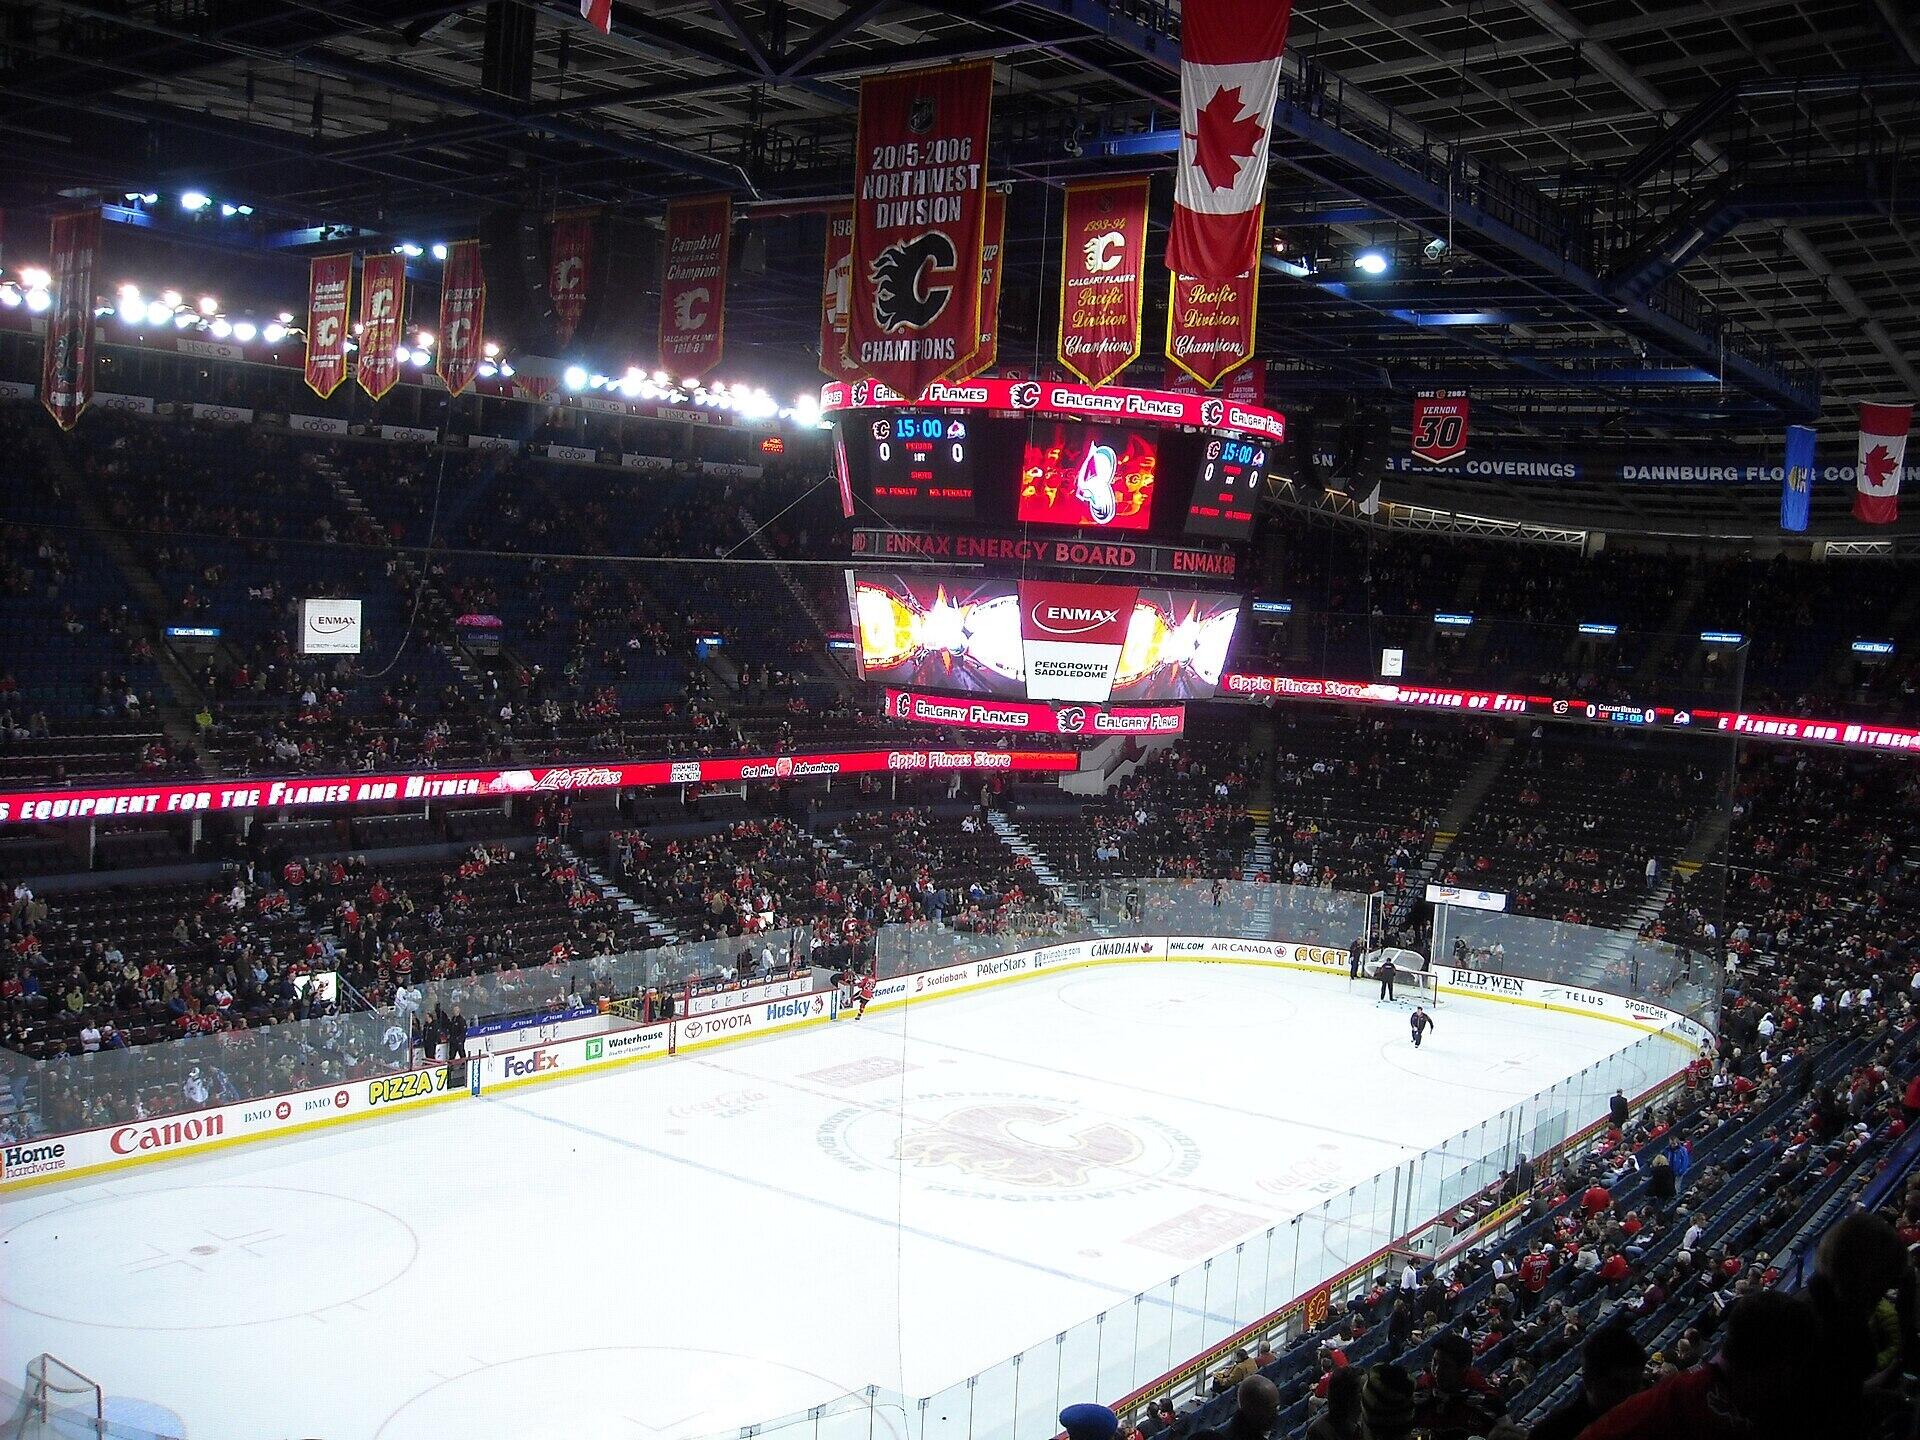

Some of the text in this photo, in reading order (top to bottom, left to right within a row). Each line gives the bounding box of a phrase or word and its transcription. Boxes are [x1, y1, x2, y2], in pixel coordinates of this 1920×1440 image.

[873, 137, 971, 170] 2005-2006
[862, 164, 981, 201] NORTHWEST
[877, 195, 961, 229] DIVISION
[671, 233, 721, 253] Campbell
[1068, 275, 1135, 287] CALGARY FLAMES
[1078, 286, 1123, 312] Pacific
[1189, 284, 1237, 310] Pacific
[1072, 309, 1127, 329] Division
[1184, 308, 1240, 329] Division
[861, 338, 955, 363] CHAMPIONS
[1064, 335, 1133, 358] Champions
[1175, 335, 1244, 359] Champions
[931, 385, 987, 402] FLAMES
[1053, 390, 1183, 417] CALGARY FLAMES
[1422, 405, 1457, 415] VERNON
[896, 419, 943, 438] 15:00
[1230, 408, 1267, 430] CALGARY
[1414, 415, 1463, 449] 30
[879, 443, 964, 462] 0 0
[1222, 442, 1252, 463] 15:00
[1205, 463, 1215, 481] 0
[1248, 470, 1258, 488] 0
[1467, 460, 1576, 478] COVERINGS
[1623, 465, 1738, 481] DANNBURG
[1746, 466, 1816, 481] FLO
[886, 533, 1136, 567] ENMAX ENERGY BOARD
[1173, 551, 1223, 574] ENMAX
[318, 616, 356, 625] ENMAX
[1048, 606, 1121, 623] ENMAX
[1034, 668, 1107, 679] SADDLEDOME
[1035, 660, 1109, 671] PENGROWTH
[1230, 675, 1271, 691] Apple
[1273, 677, 1322, 693] Fitness
[1325, 680, 1360, 695] Store
[1398, 690, 1462, 707] UPPLIER
[916, 701, 1028, 726] CALGARY FLAMES
[1587, 704, 1596, 718] 0
[1611, 713, 1643, 722] 15:00
[1645, 709, 1655, 722] 0
[1095, 712, 1150, 730] CALGARY
[1735, 715, 1797, 736] FLAMES
[672, 763, 699, 773] HAMMER
[742, 762, 840, 778] Get the Advantage
[889, 752, 1010, 770] Apple Fitness Store
[671, 772, 699, 782] STRENGTH
[20, 795, 160, 819] EQUIPMENT
[168, 792, 211, 811] FOR
[221, 790, 260, 807] THE
[269, 782, 350, 805] FLAMES
[357, 783, 397, 800] AND
[1091, 942, 1139, 957] CANADIAN
[1170, 942, 1204, 950] NHL.COM
[1211, 942, 1272, 955] AIR CANADA
[977, 957, 1026, 976] PokerStars
[927, 970, 968, 986] Scotiabank
[1565, 991, 1604, 1006] TELUS
[766, 1000, 810, 1021] Husky
[705, 1016, 752, 1034] TOYOTA
[608, 1032, 663, 1048] Waterhouse
[504, 1049, 559, 1078] FedEx
[368, 1068, 448, 1105] PIZZA 7
[304, 1098, 331, 1111] BMO
[244, 1108, 272, 1123] BMO
[110, 1114, 224, 1155] Canon
[5, 1143, 65, 1167] Home
[5, 1159, 66, 1179] hardware
